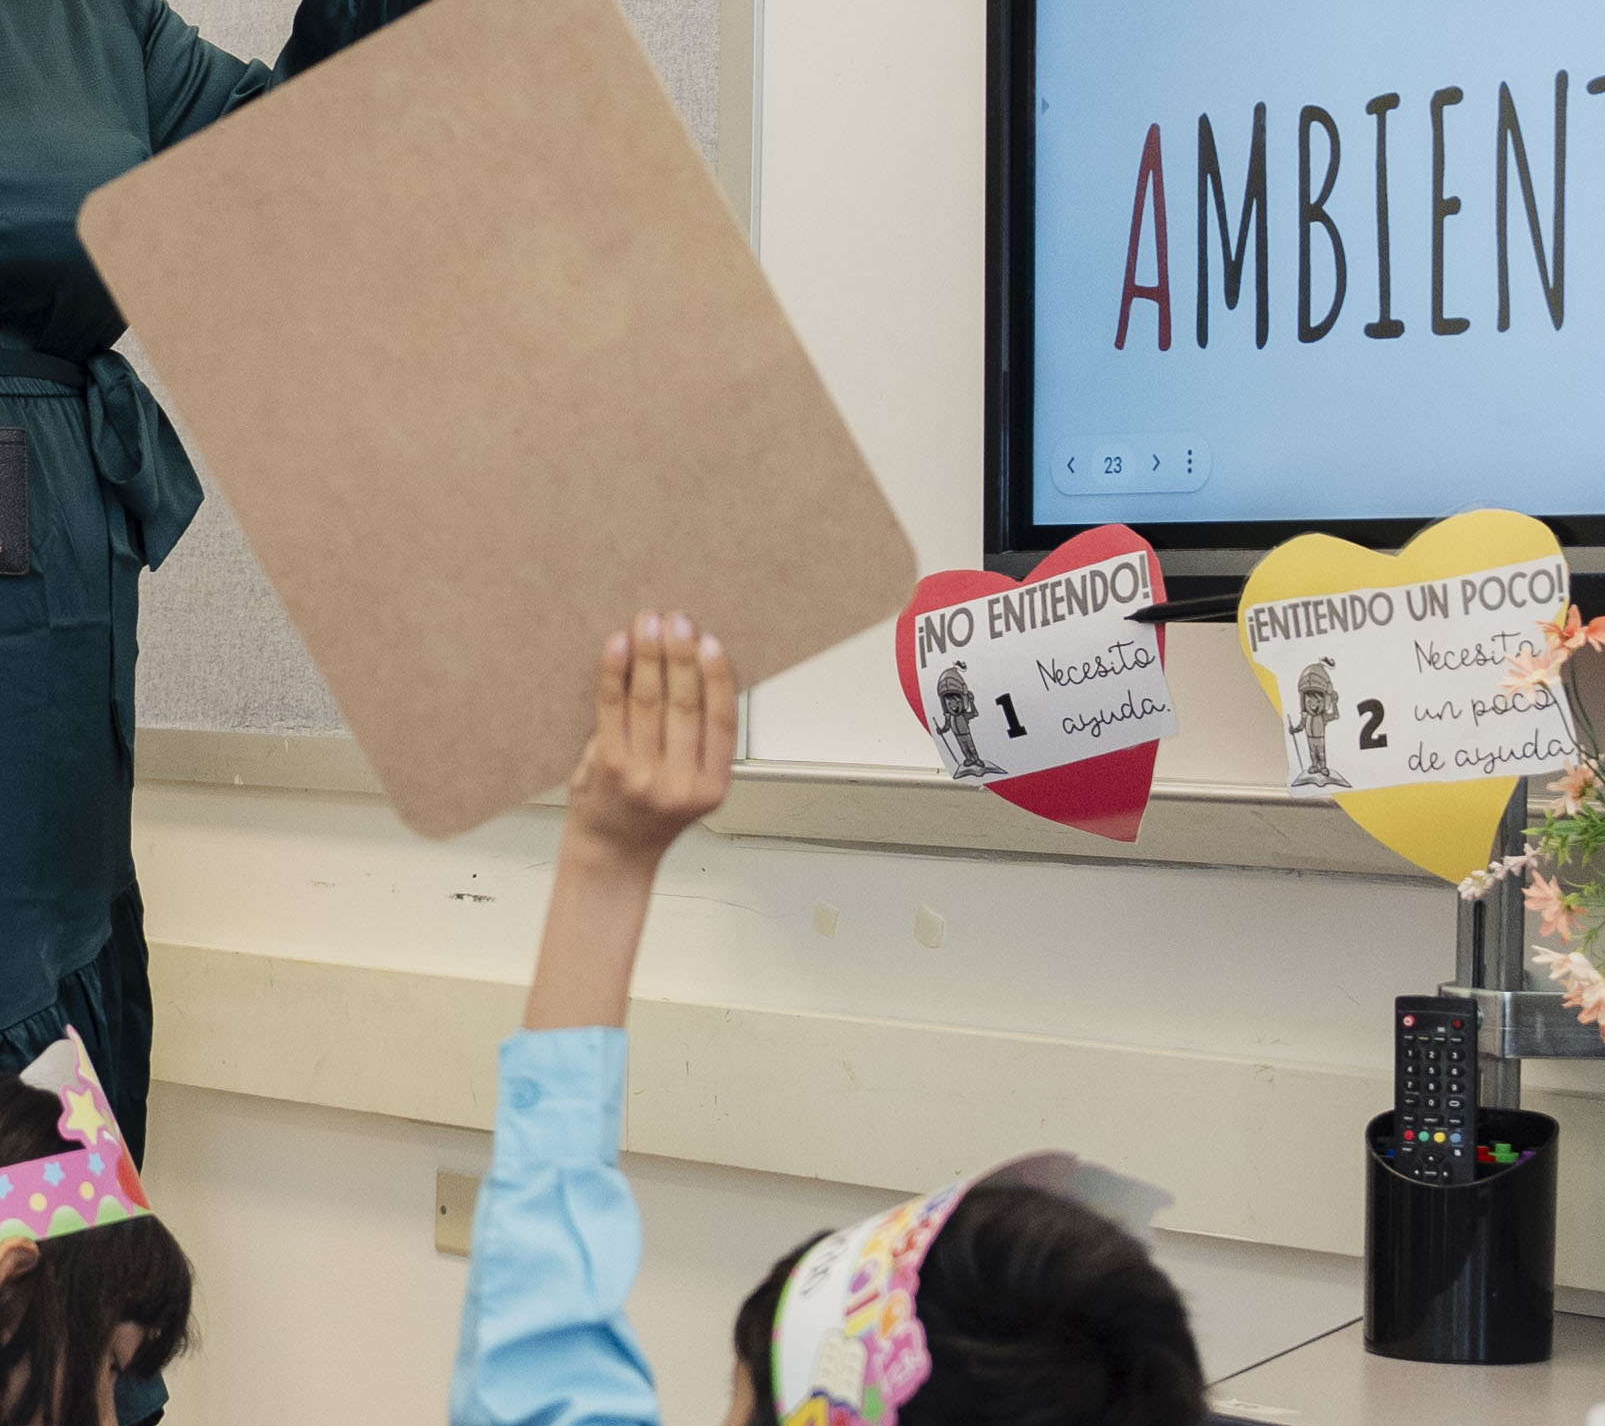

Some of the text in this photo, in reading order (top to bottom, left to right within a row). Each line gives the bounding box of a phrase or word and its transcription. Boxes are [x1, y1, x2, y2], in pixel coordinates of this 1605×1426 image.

[1103, 455, 1123, 475] 23
[987, 560, 1152, 643] ENTIENDO!
[1246, 563, 1566, 652] ¡ENTIENDO UN POCO!
[1036, 640, 1156, 693] Necesito
[994, 694, 1028, 740] 1
[1356, 688, 1557, 751] 2 un poco
[1408, 741, 1446, 773] de
